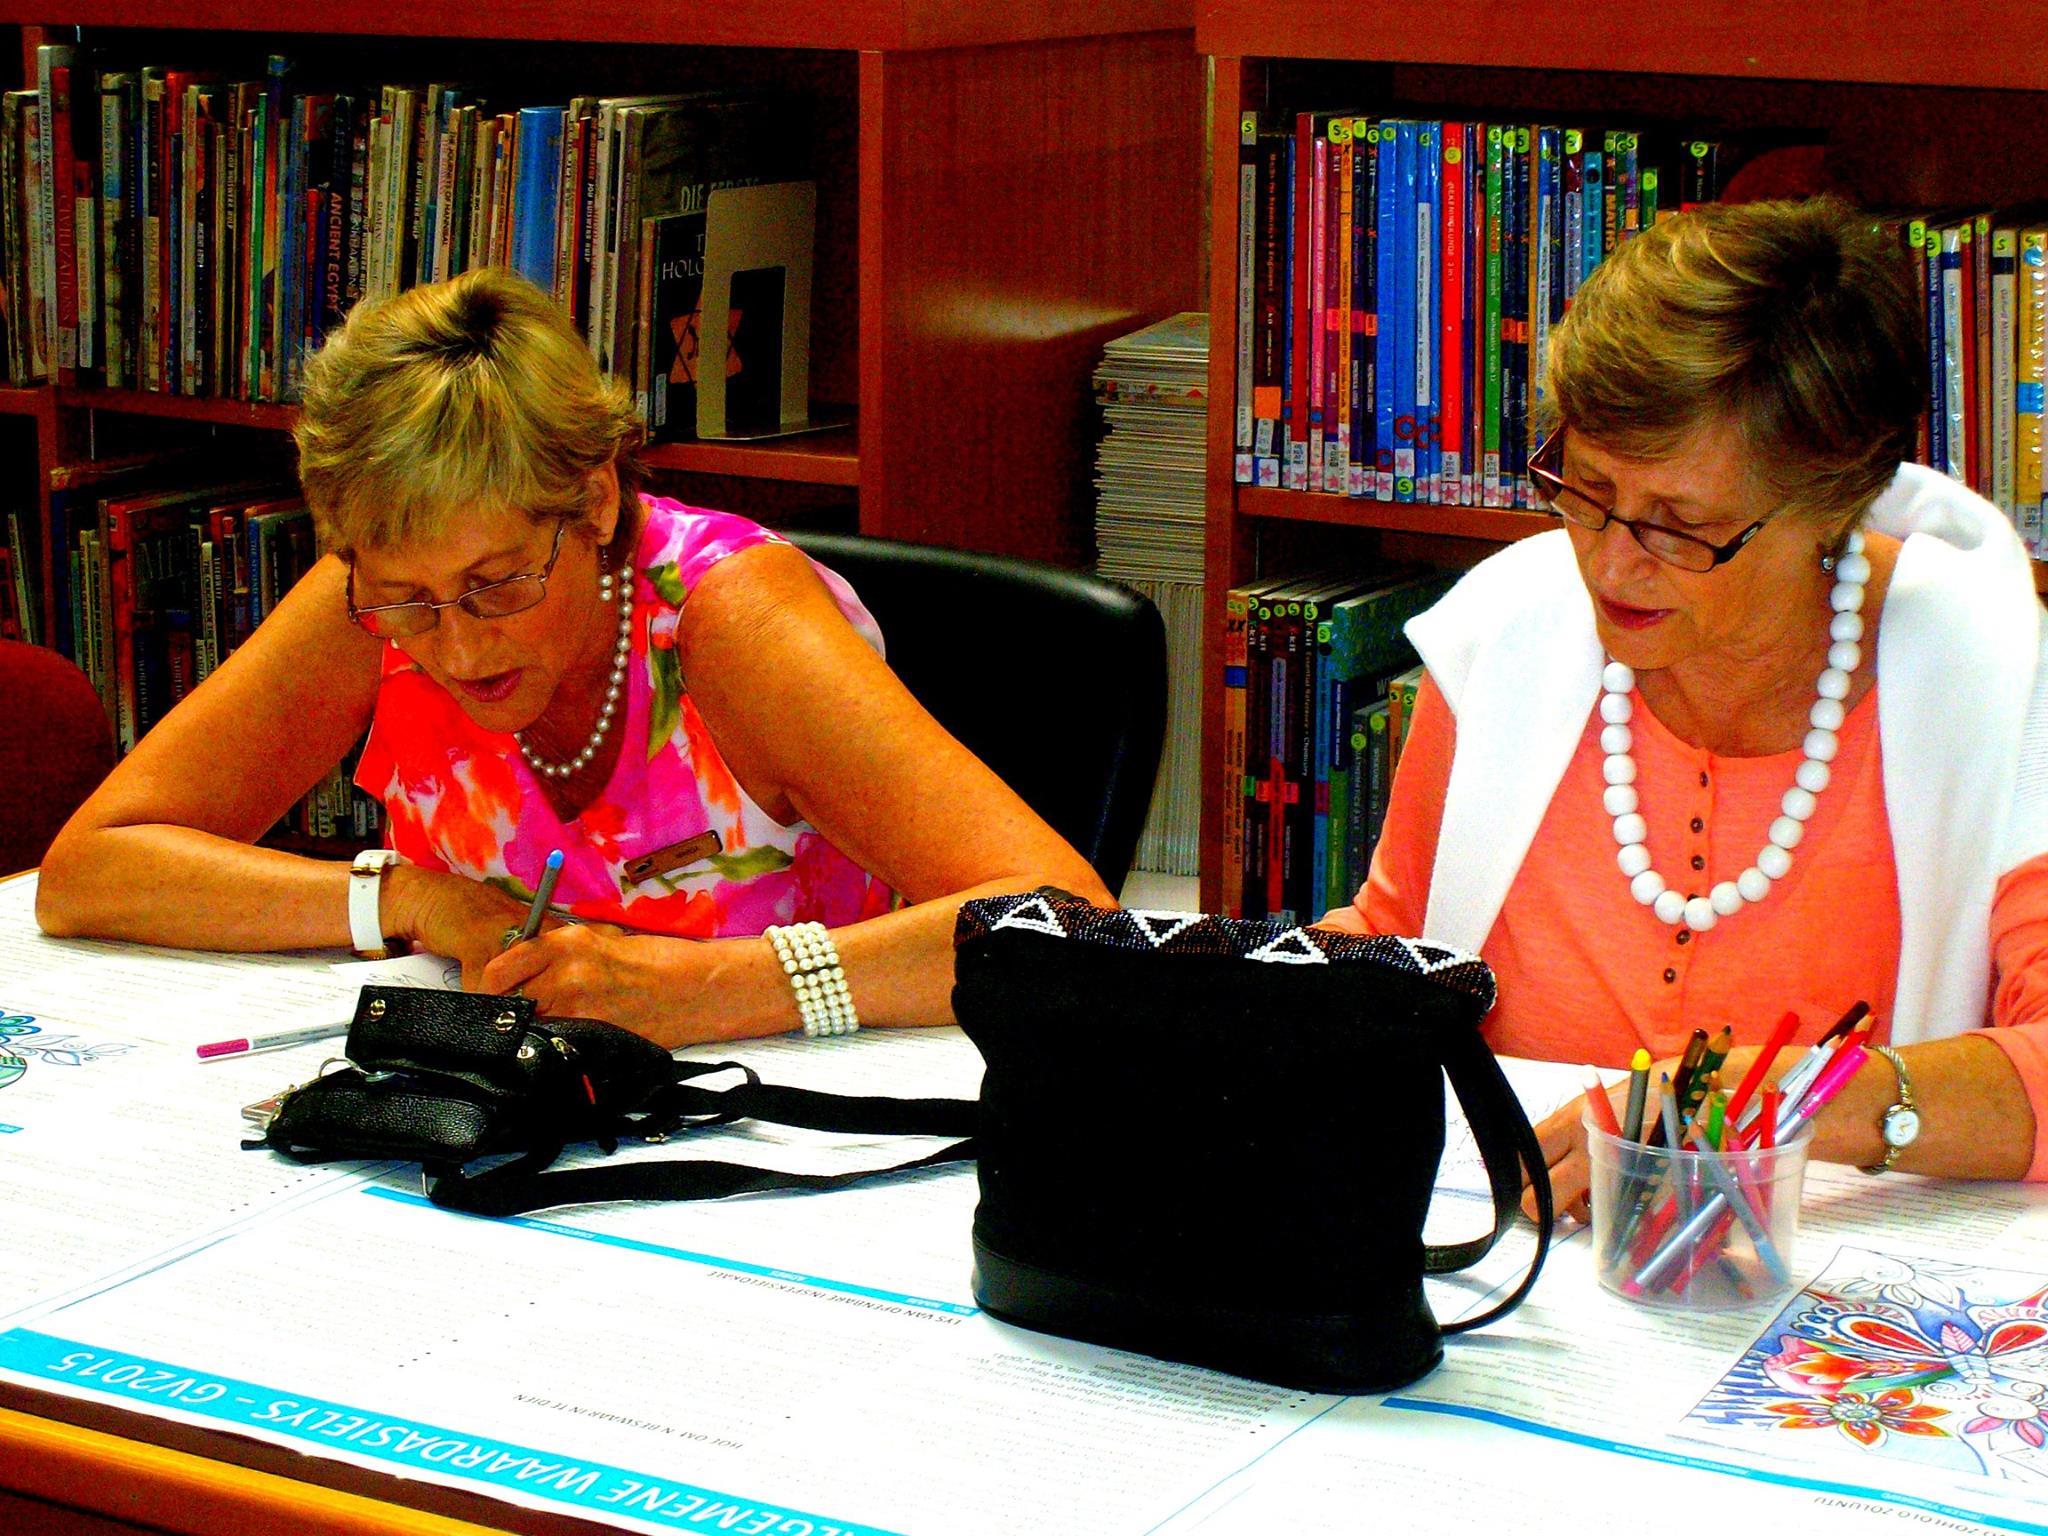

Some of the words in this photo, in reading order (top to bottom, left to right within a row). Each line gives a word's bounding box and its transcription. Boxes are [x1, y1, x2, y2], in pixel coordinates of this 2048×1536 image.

[226, 153, 235, 167] JOU
[586, 182, 595, 198] JOU
[680, 184, 704, 211] DIE
[328, 192, 344, 260] ANCIENT
[441, 204, 451, 246] HANNIBAL
[584, 200, 594, 240] HUISWERK
[1446, 182, 1456, 256] REKENINGKUNDE
[1605, 193, 1616, 252] MATHS
[583, 242, 592, 263] HULP
[325, 263, 340, 311] EGYPT
[1304, 651, 1312, 687] Essential
[1301, 736, 1310, 777] Chemistry
[706, 1270, 826, 1298] INSPEKSIELOKALE
[827, 1293, 902, 1315] OPENBARE
[903, 1308, 933, 1320] VAN
[934, 1314, 962, 1326] LYS
[46, 1351, 228, 1403] GV2015
[513, 1393, 551, 1406] DIEN
[550, 1402, 568, 1411] TE
[568, 1406, 587, 1415] IN
[588, 1410, 661, 1432] BESWAAR
[251, 1399, 598, 1496] WAARDASIELYS
[680, 1430, 708, 1443] OM
[1813, 1496, 1894, 1516] ZOLUNTU
[1897, 1510, 1979, 1534] ZOHLOLO
